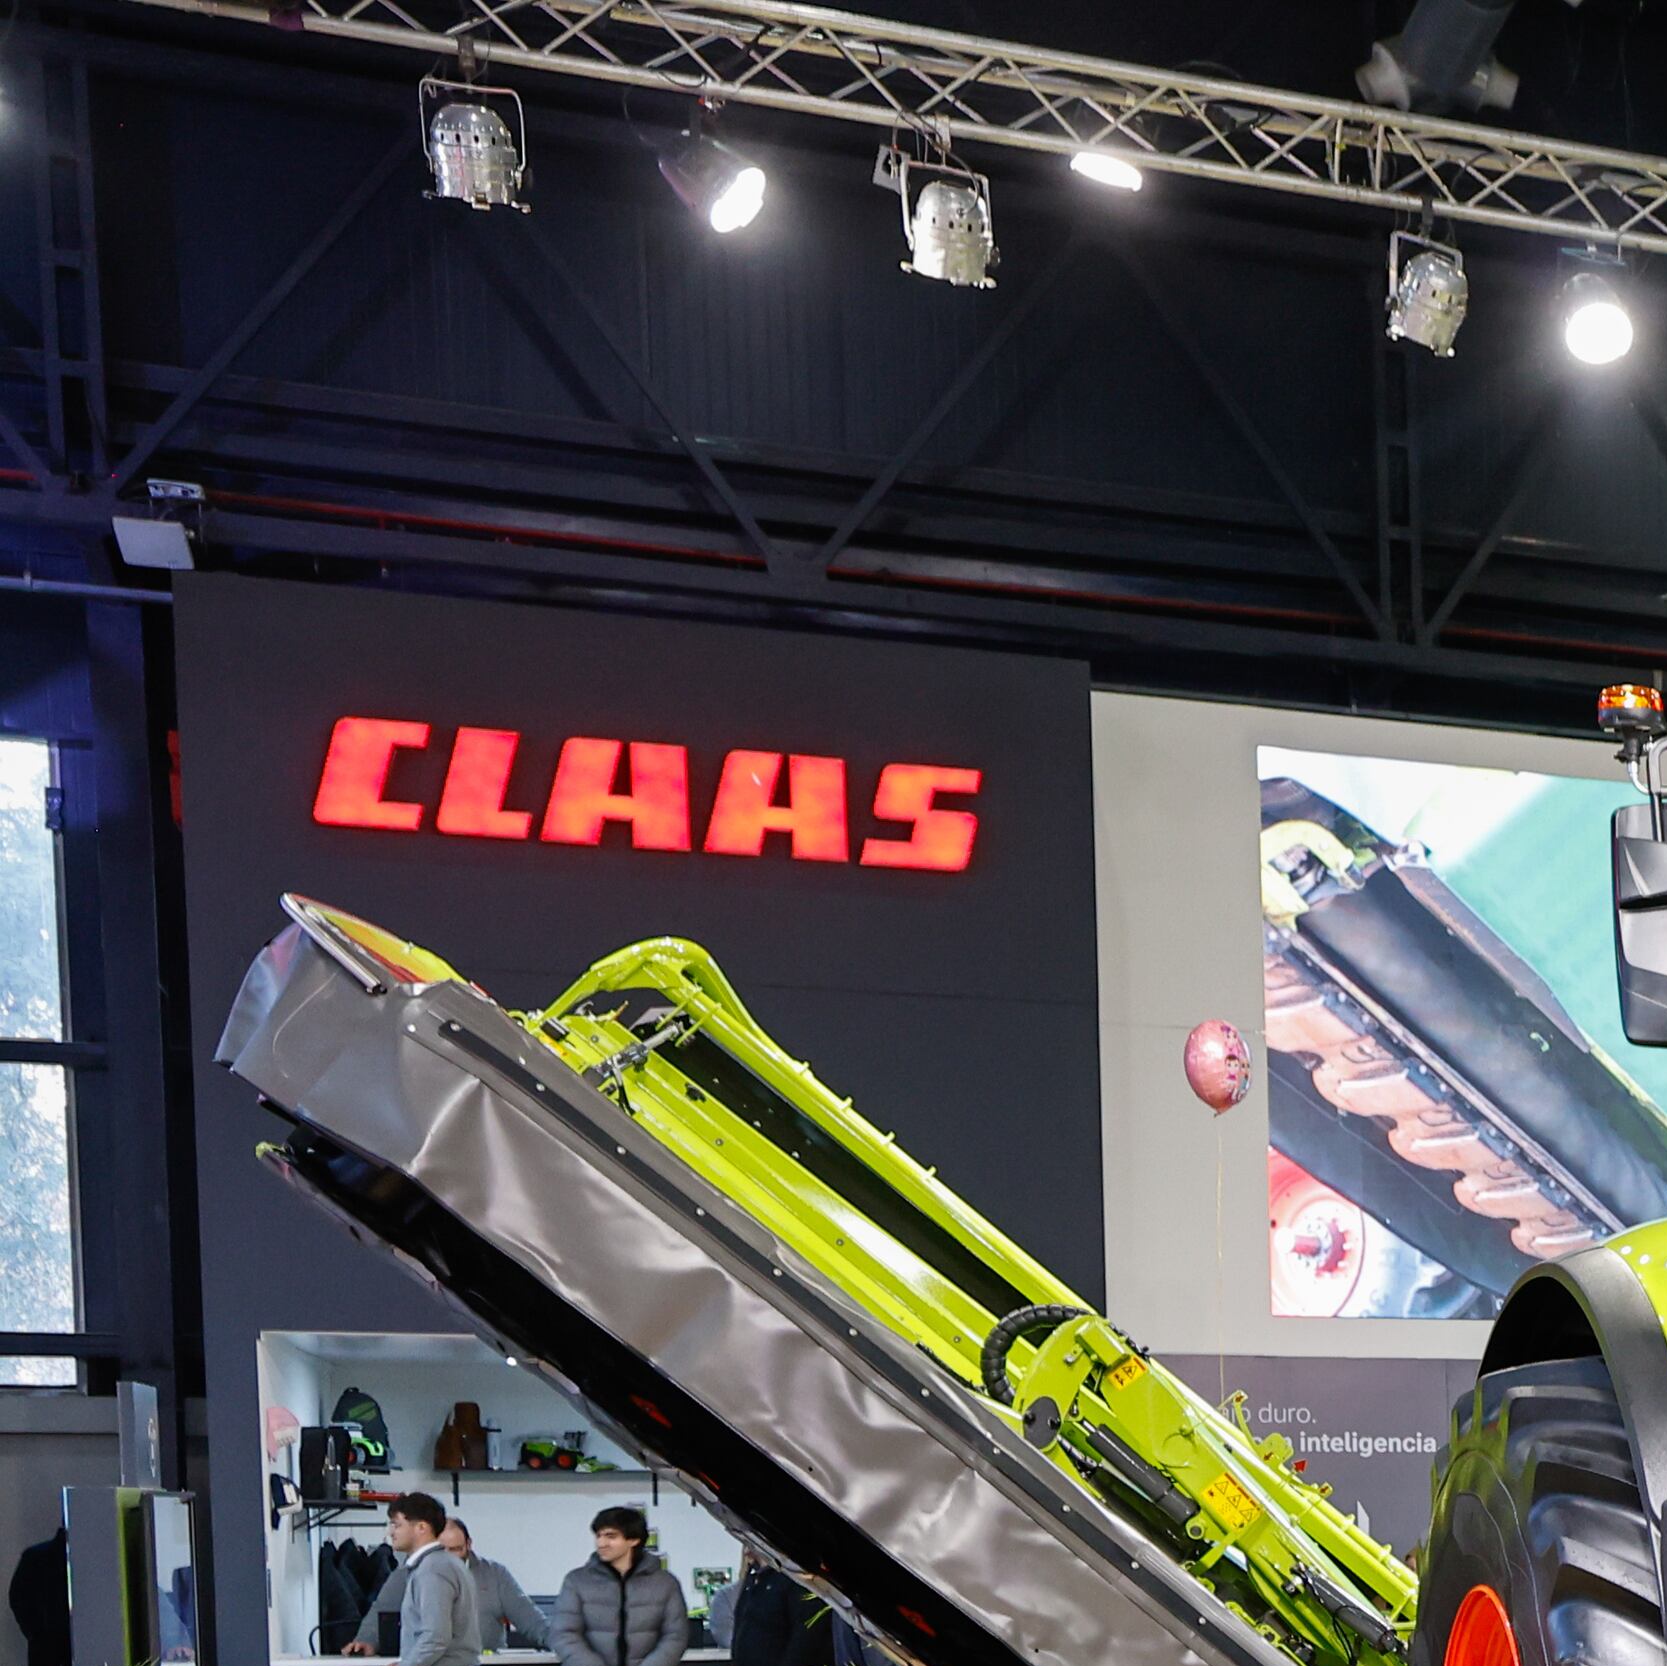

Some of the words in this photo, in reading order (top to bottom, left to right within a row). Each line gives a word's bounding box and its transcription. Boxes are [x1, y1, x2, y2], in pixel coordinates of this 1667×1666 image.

[313, 716, 982, 872] CLAAS
[1258, 1402, 1317, 1424] duro.
[1300, 1431, 1438, 1458] inteligencia
